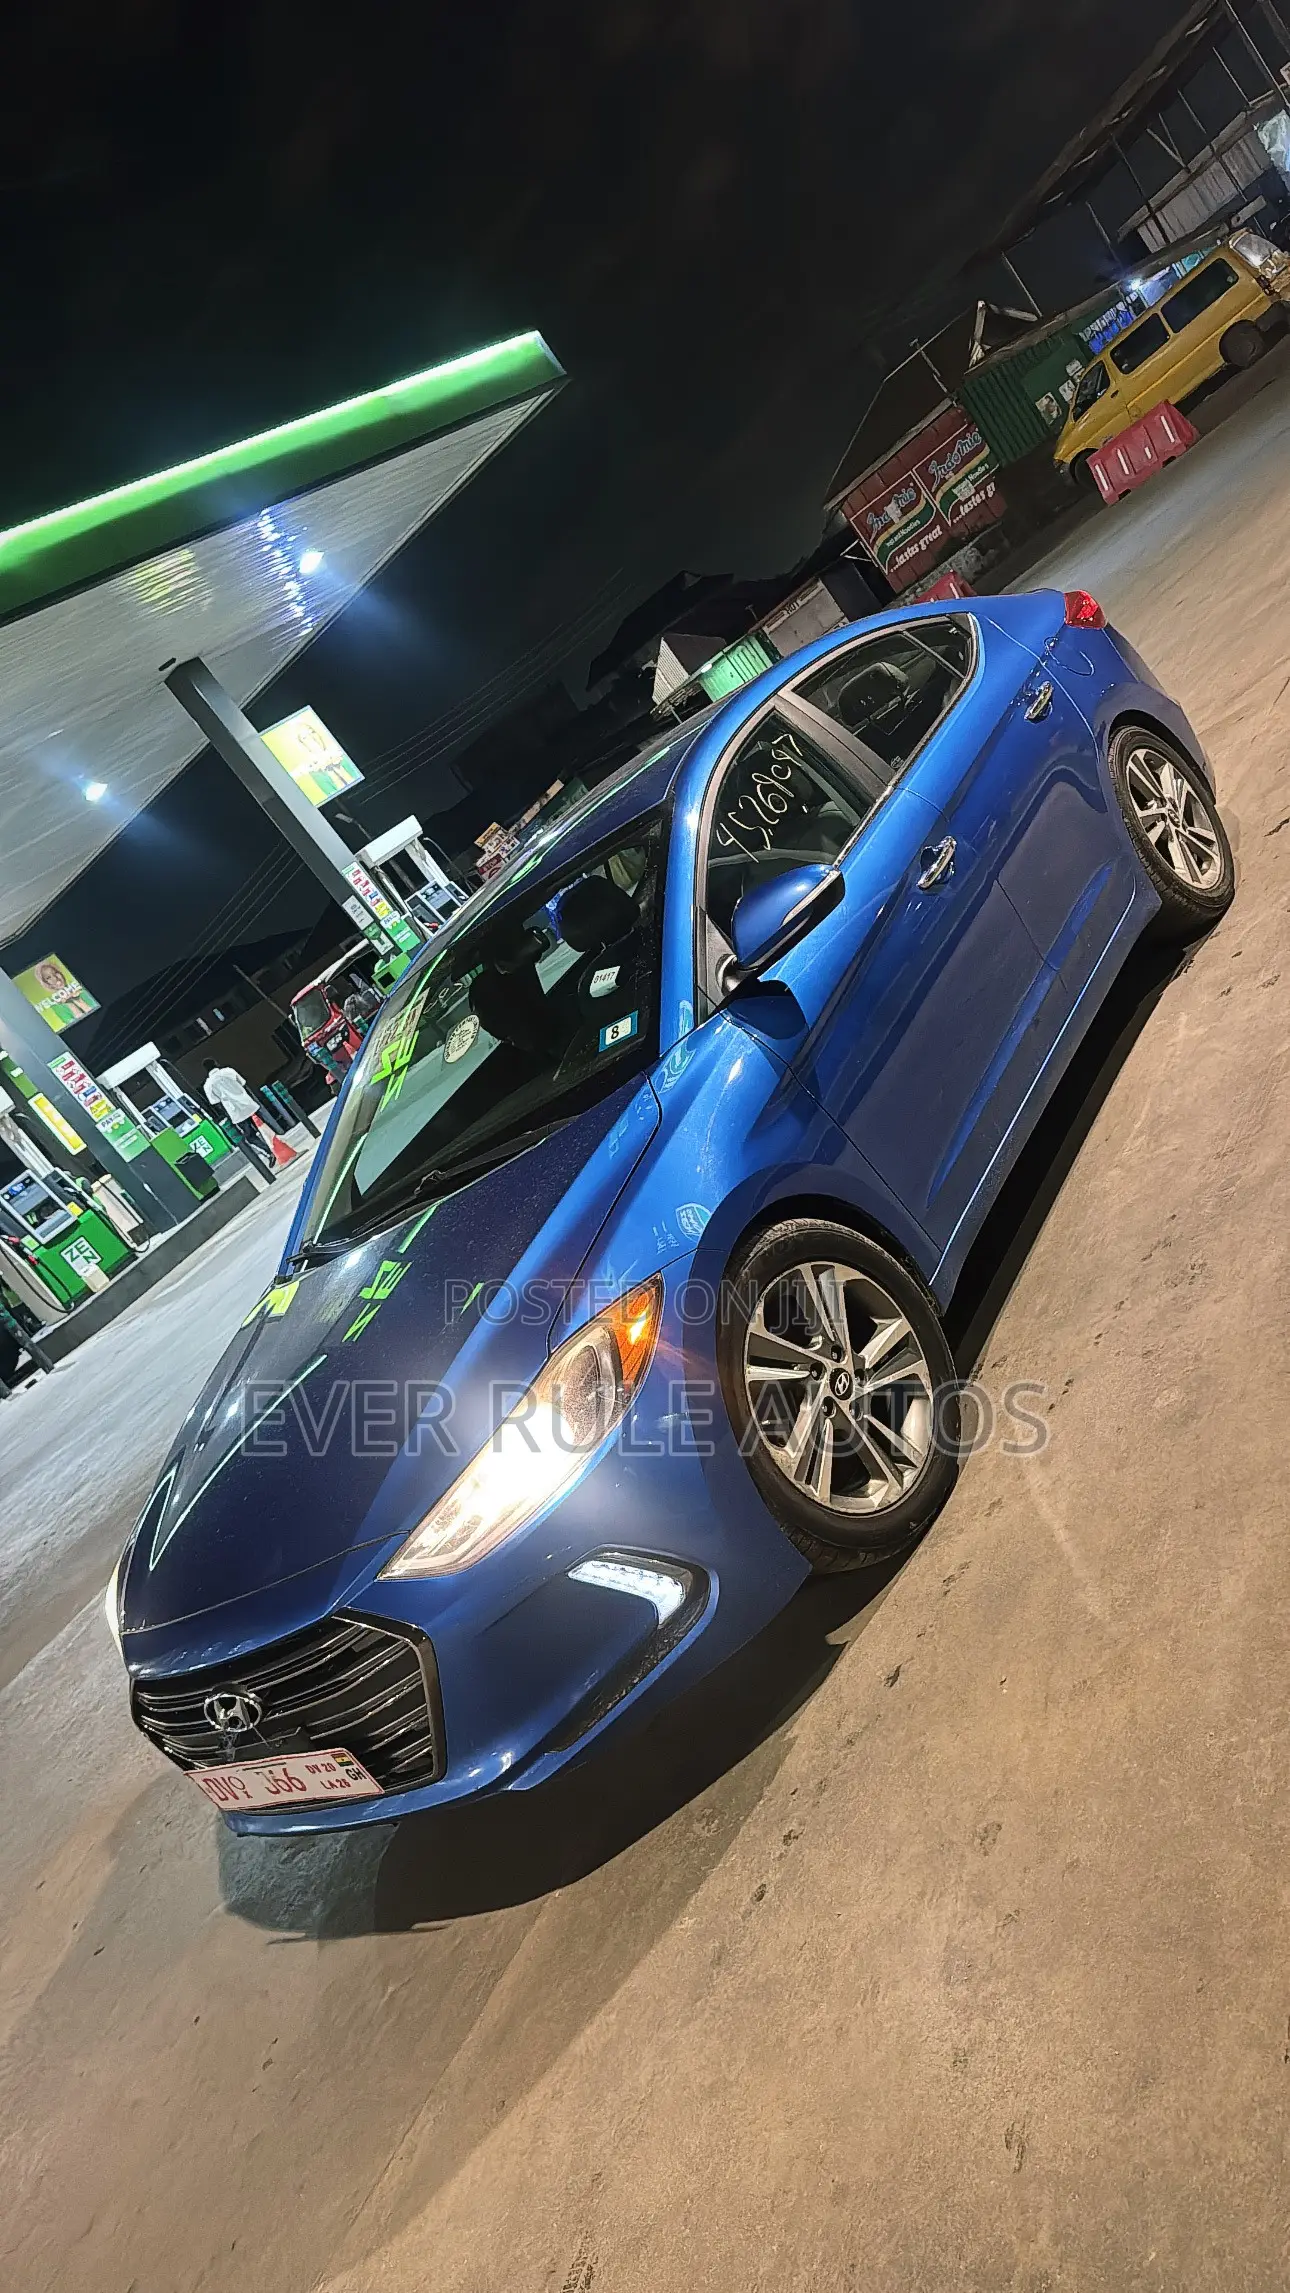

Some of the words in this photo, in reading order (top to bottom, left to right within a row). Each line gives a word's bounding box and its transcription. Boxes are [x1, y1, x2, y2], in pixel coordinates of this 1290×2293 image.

[918, 524, 942, 552] great
[33, 981, 82, 1012] WELCOME
[610, 1025, 620, 1040] 8
[344, 1767, 368, 1782] GH
